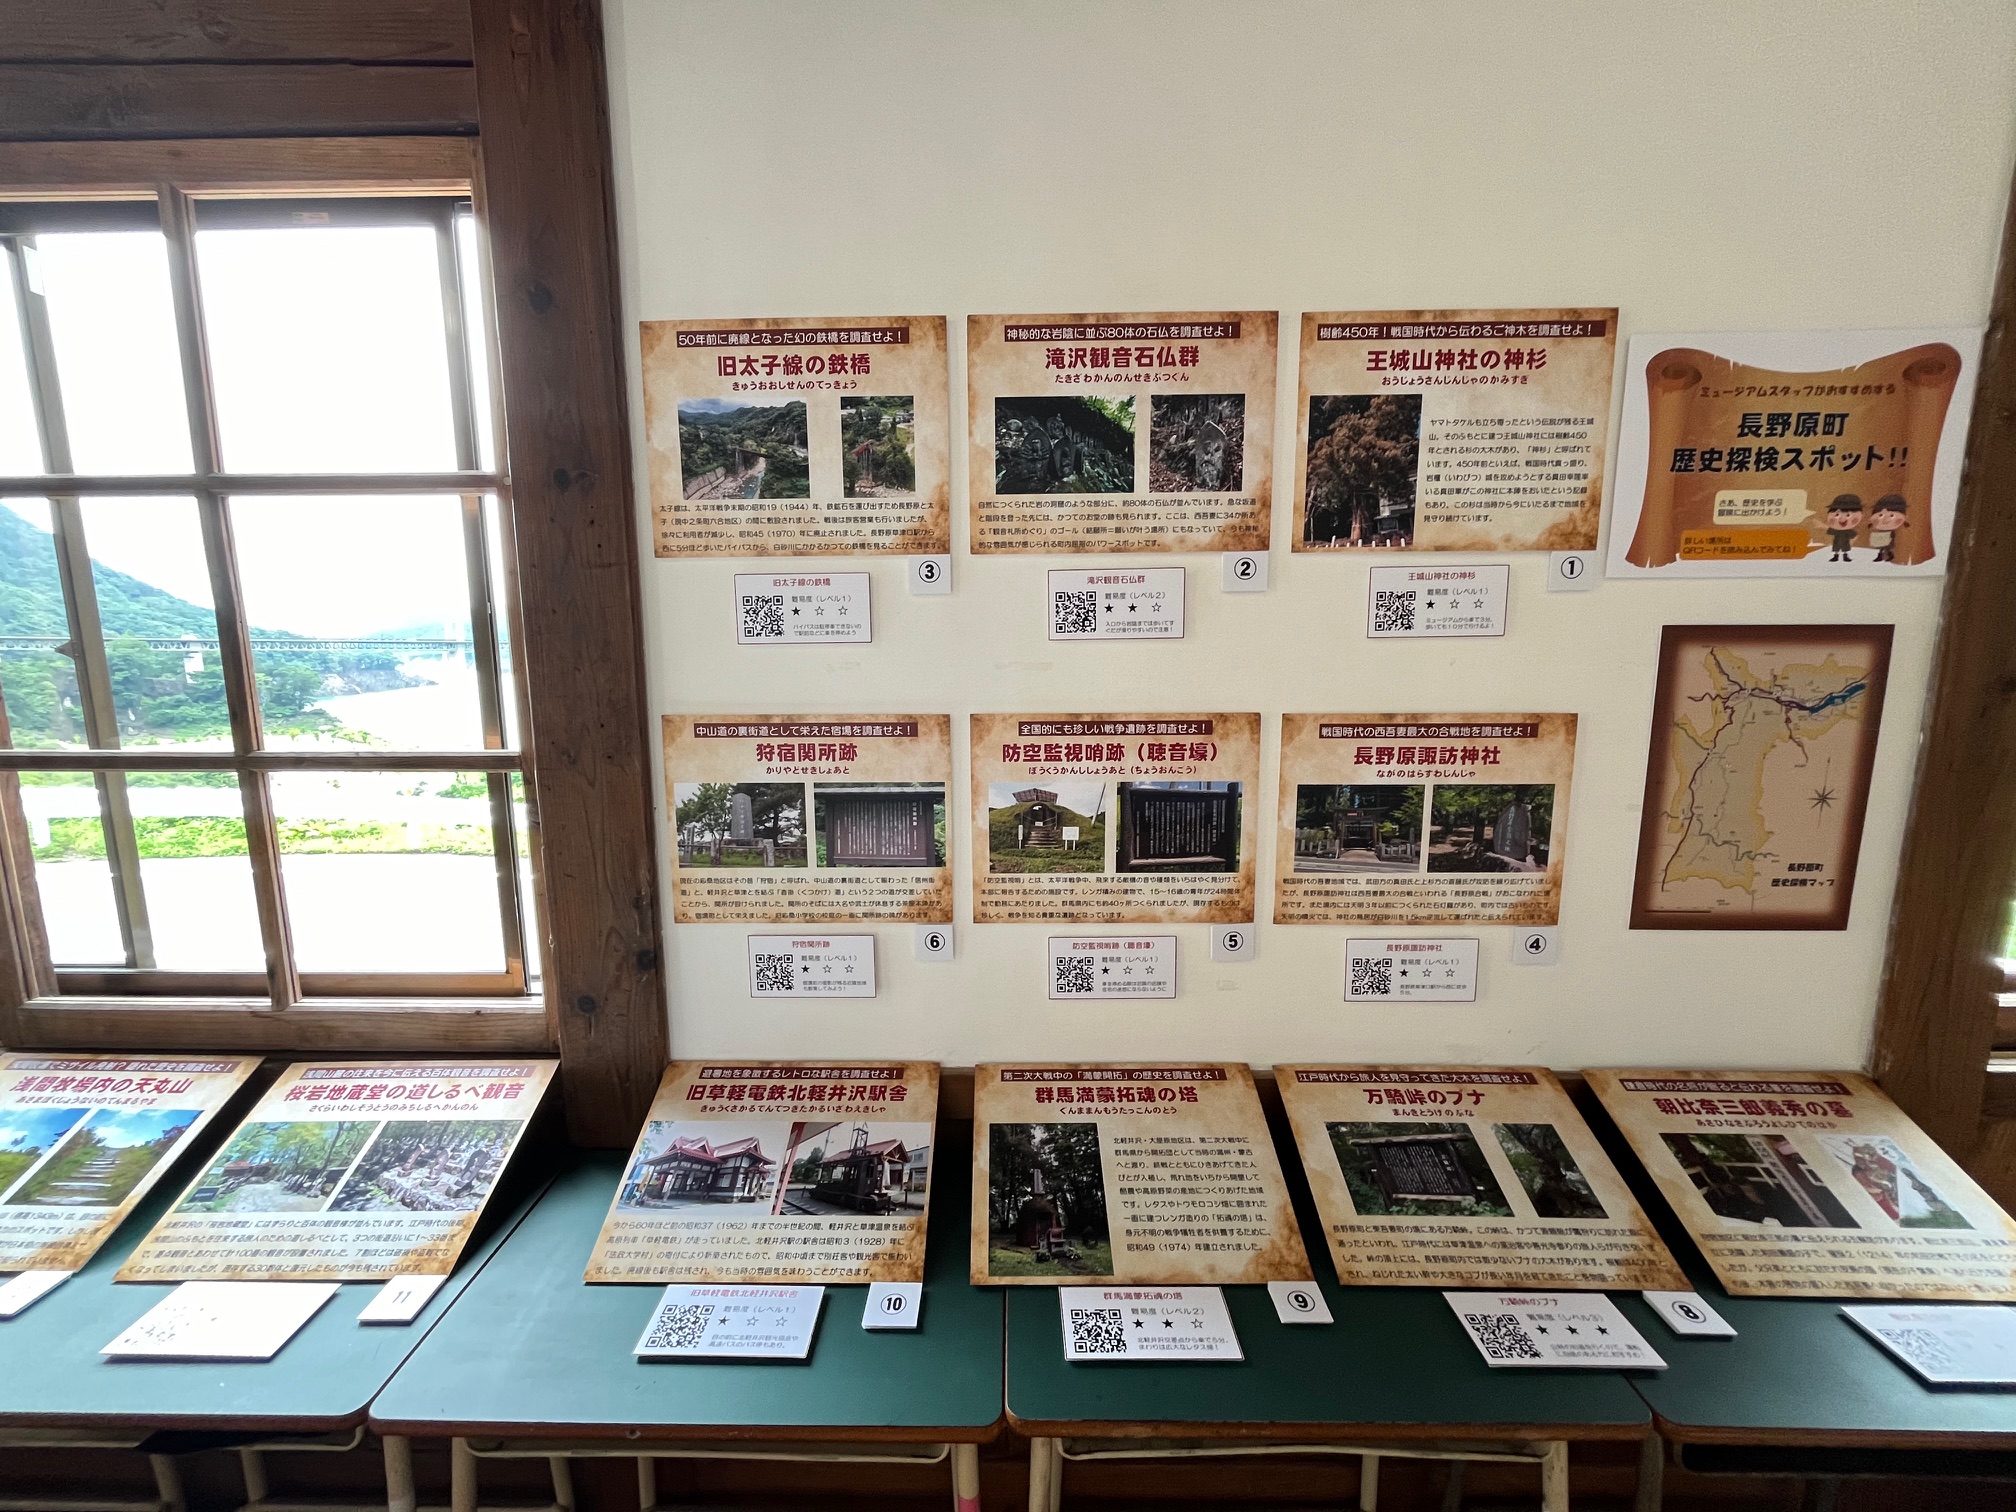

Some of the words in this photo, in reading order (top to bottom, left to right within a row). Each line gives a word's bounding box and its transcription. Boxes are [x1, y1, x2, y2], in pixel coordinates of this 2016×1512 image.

[1007, 325, 1234, 340] 神秘的な岩陰に並ぶ80体の石仏を調査せよ！
[1320, 323, 1592, 339] 樹齢450年！戦国時代から伝わるご神木を調査せよ！
[679, 330, 903, 346] 50年前に廃線となった幻の鉄橋を調査せよ！
[1045, 346, 1200, 369] 滝沢観音石仏群
[1367, 347, 1547, 371] 王城山神社の神杉
[717, 353, 871, 377] 旧太子線の鉄橋
[1055, 372, 1189, 383] たきざわかんのんせきぶつぐん
[1382, 374, 1528, 386] おうじょうさんじんじゃのかみすぎ
[732, 380, 857, 391] きゅうおおしせんのてっきょう
[1700, 383, 1897, 398] ミュージアムスタッフがおすすめする
[1737, 412, 1849, 439] 長野原町
[773, 578, 831, 587] 旧太子線の鉄橋
[1087, 575, 1145, 585] 滝沢観音石仏群
[1408, 571, 1475, 581] 王城山神社の神杉
[696, 725, 912, 736] 中山道の裏街道として栄えた宿場を調査せよ！
[1021, 723, 1206, 735] 全国的にも珍しい戦争遺跡を調査せよ！
[1321, 726, 1532, 737] 戦国時代の西吾妻最大の合戦地を調査せよ！
[756, 742, 858, 762] 狩宿関所跡
[1002, 742, 1219, 763] 防空監視哨跡（聴音壕）
[1354, 746, 1501, 766] 長野原諏訪神社
[766, 766, 850, 775] かりやどせきしょあと
[1376, 769, 1477, 778] ながのはらすわじんじゃ
[1787, 862, 1824, 872] 長野原町
[792, 940, 830, 948] 狩宿関所跡
[1386, 944, 1443, 952] 長野原諏訪神社
[702, 1069, 899, 1078] 避暑地を象徴するレトロな駅舎を調査せよ！
[9, 1076, 194, 1094] 浅間牧場内の天丸山
[284, 1083, 526, 1102] 桜岩地蔵堂の道しるべ観音
[686, 1084, 908, 1102] 旧草軽電鉄北軽井沢駅舎
[1035, 1086, 1198, 1104] 群馬満蒙拓魂の塔
[1363, 1087, 1486, 1106] 万騎峠のブナ
[1653, 1098, 1854, 1118] 朝比奈三郎義秀の墓
[690, 1289, 799, 1299] 旧草軽電鉄北軽井沢駅舎
[1104, 1291, 1183, 1300] 群馬満蒙拓魂の塔
